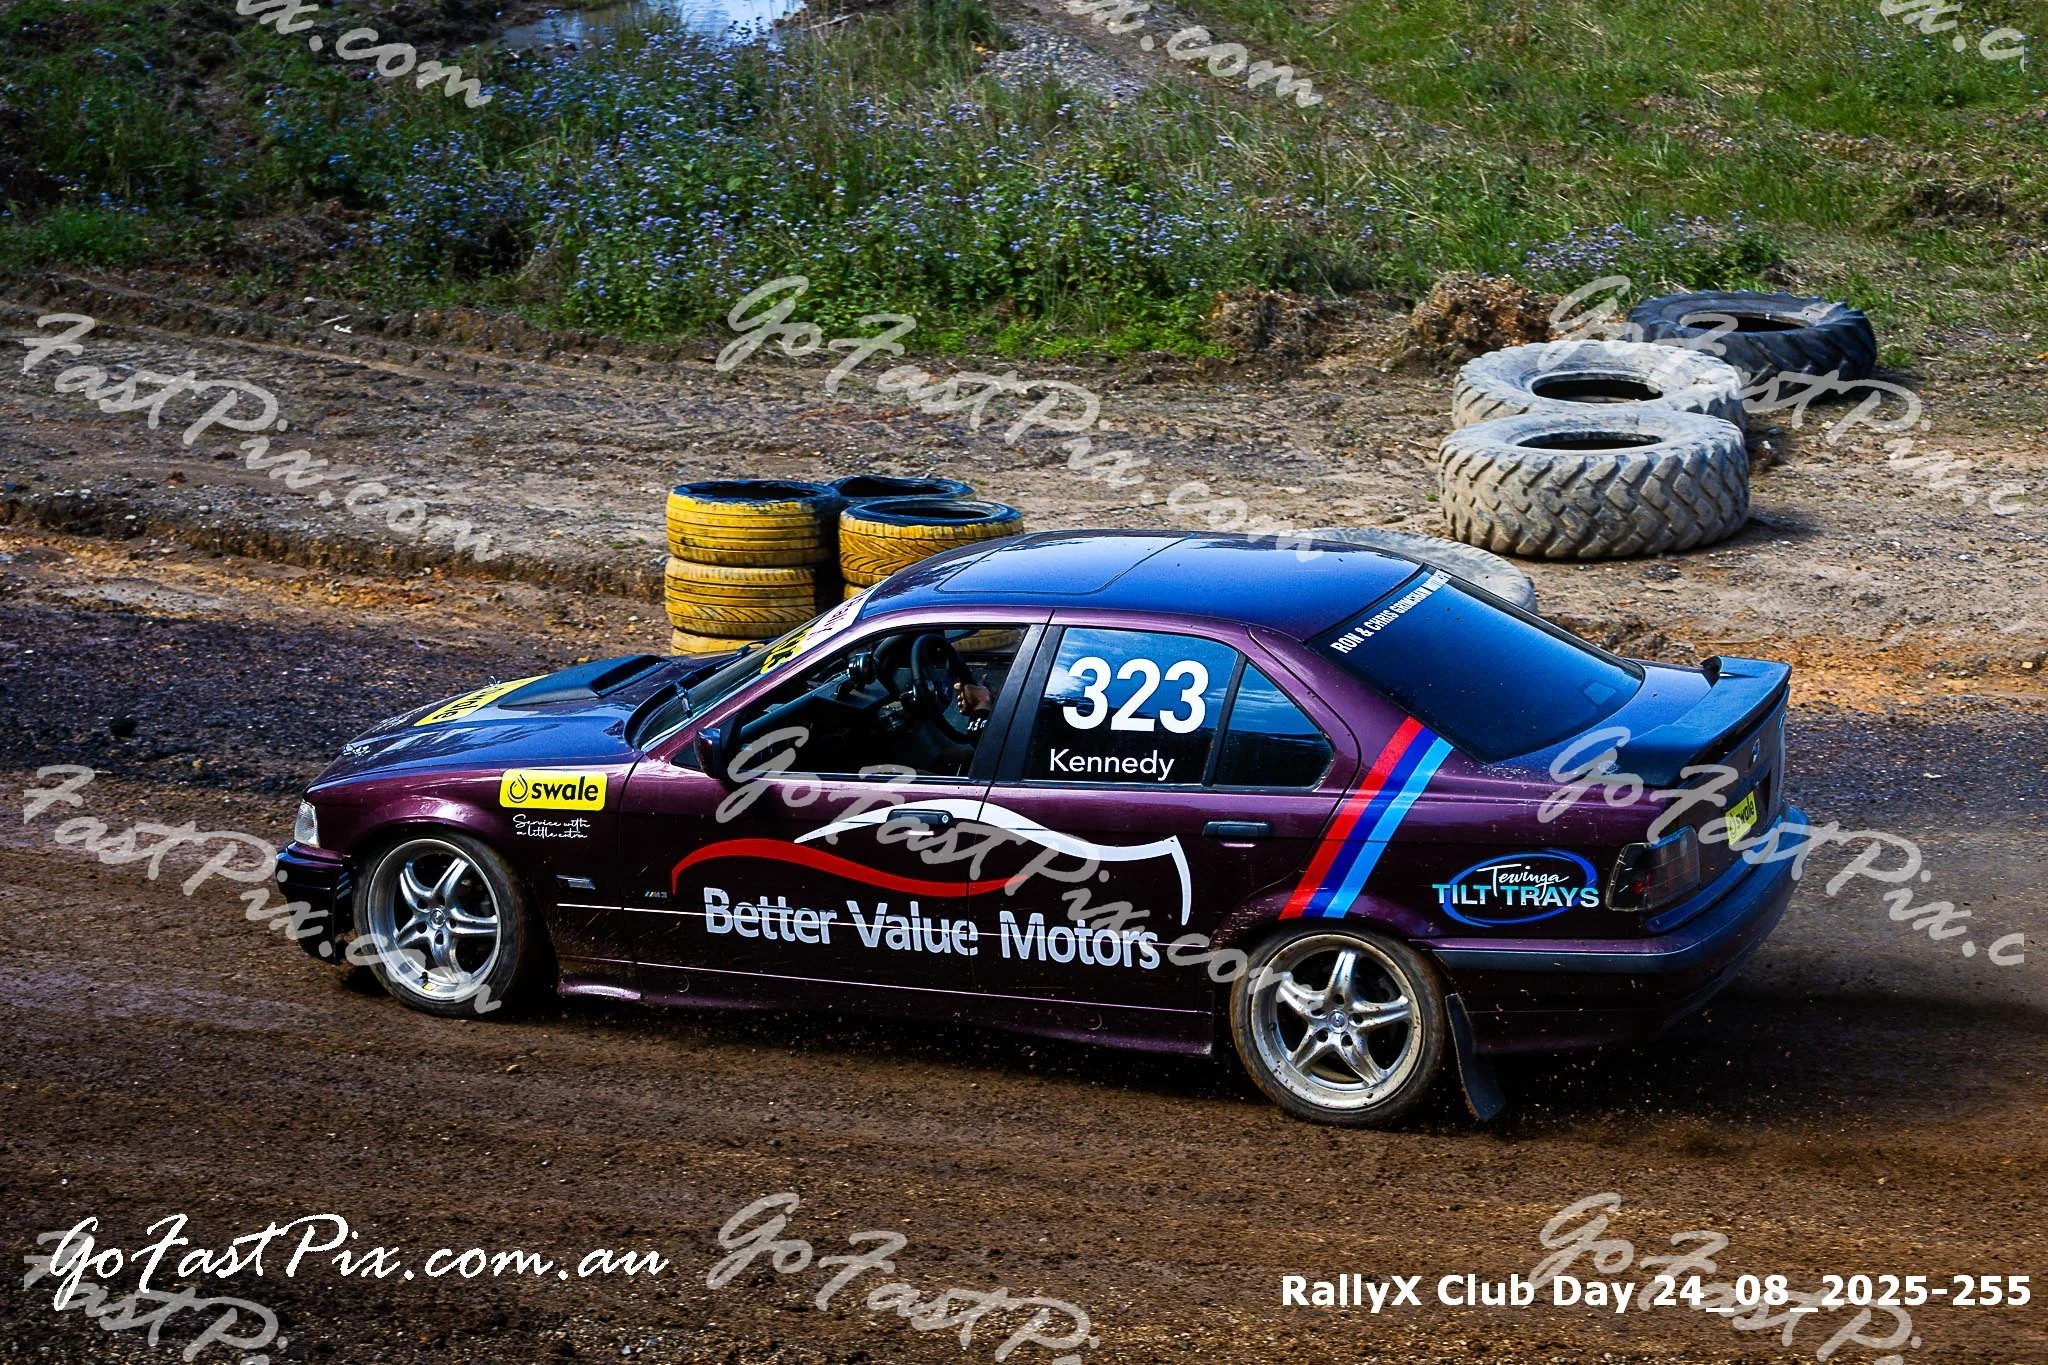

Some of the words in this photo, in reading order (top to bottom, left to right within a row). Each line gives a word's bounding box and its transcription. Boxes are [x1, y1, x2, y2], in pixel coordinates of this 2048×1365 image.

[1364, 609, 1399, 631] CHRIS
[1330, 632, 1364, 653] RON
[1355, 627, 1374, 647] &
[1063, 656, 1209, 733] 323
[1050, 748, 1175, 781] Kennedy
[531, 776, 598, 801] swale
[513, 813, 561, 828] Service
[563, 818, 591, 833] with
[527, 823, 558, 839] little
[1476, 863, 1569, 900] Tewinga
[1432, 884, 1491, 905] TILT
[1500, 886, 1599, 908] TRAYS
[704, 887, 837, 944] Better
[847, 900, 978, 956] Value
[1000, 910, 1161, 970] Motors
